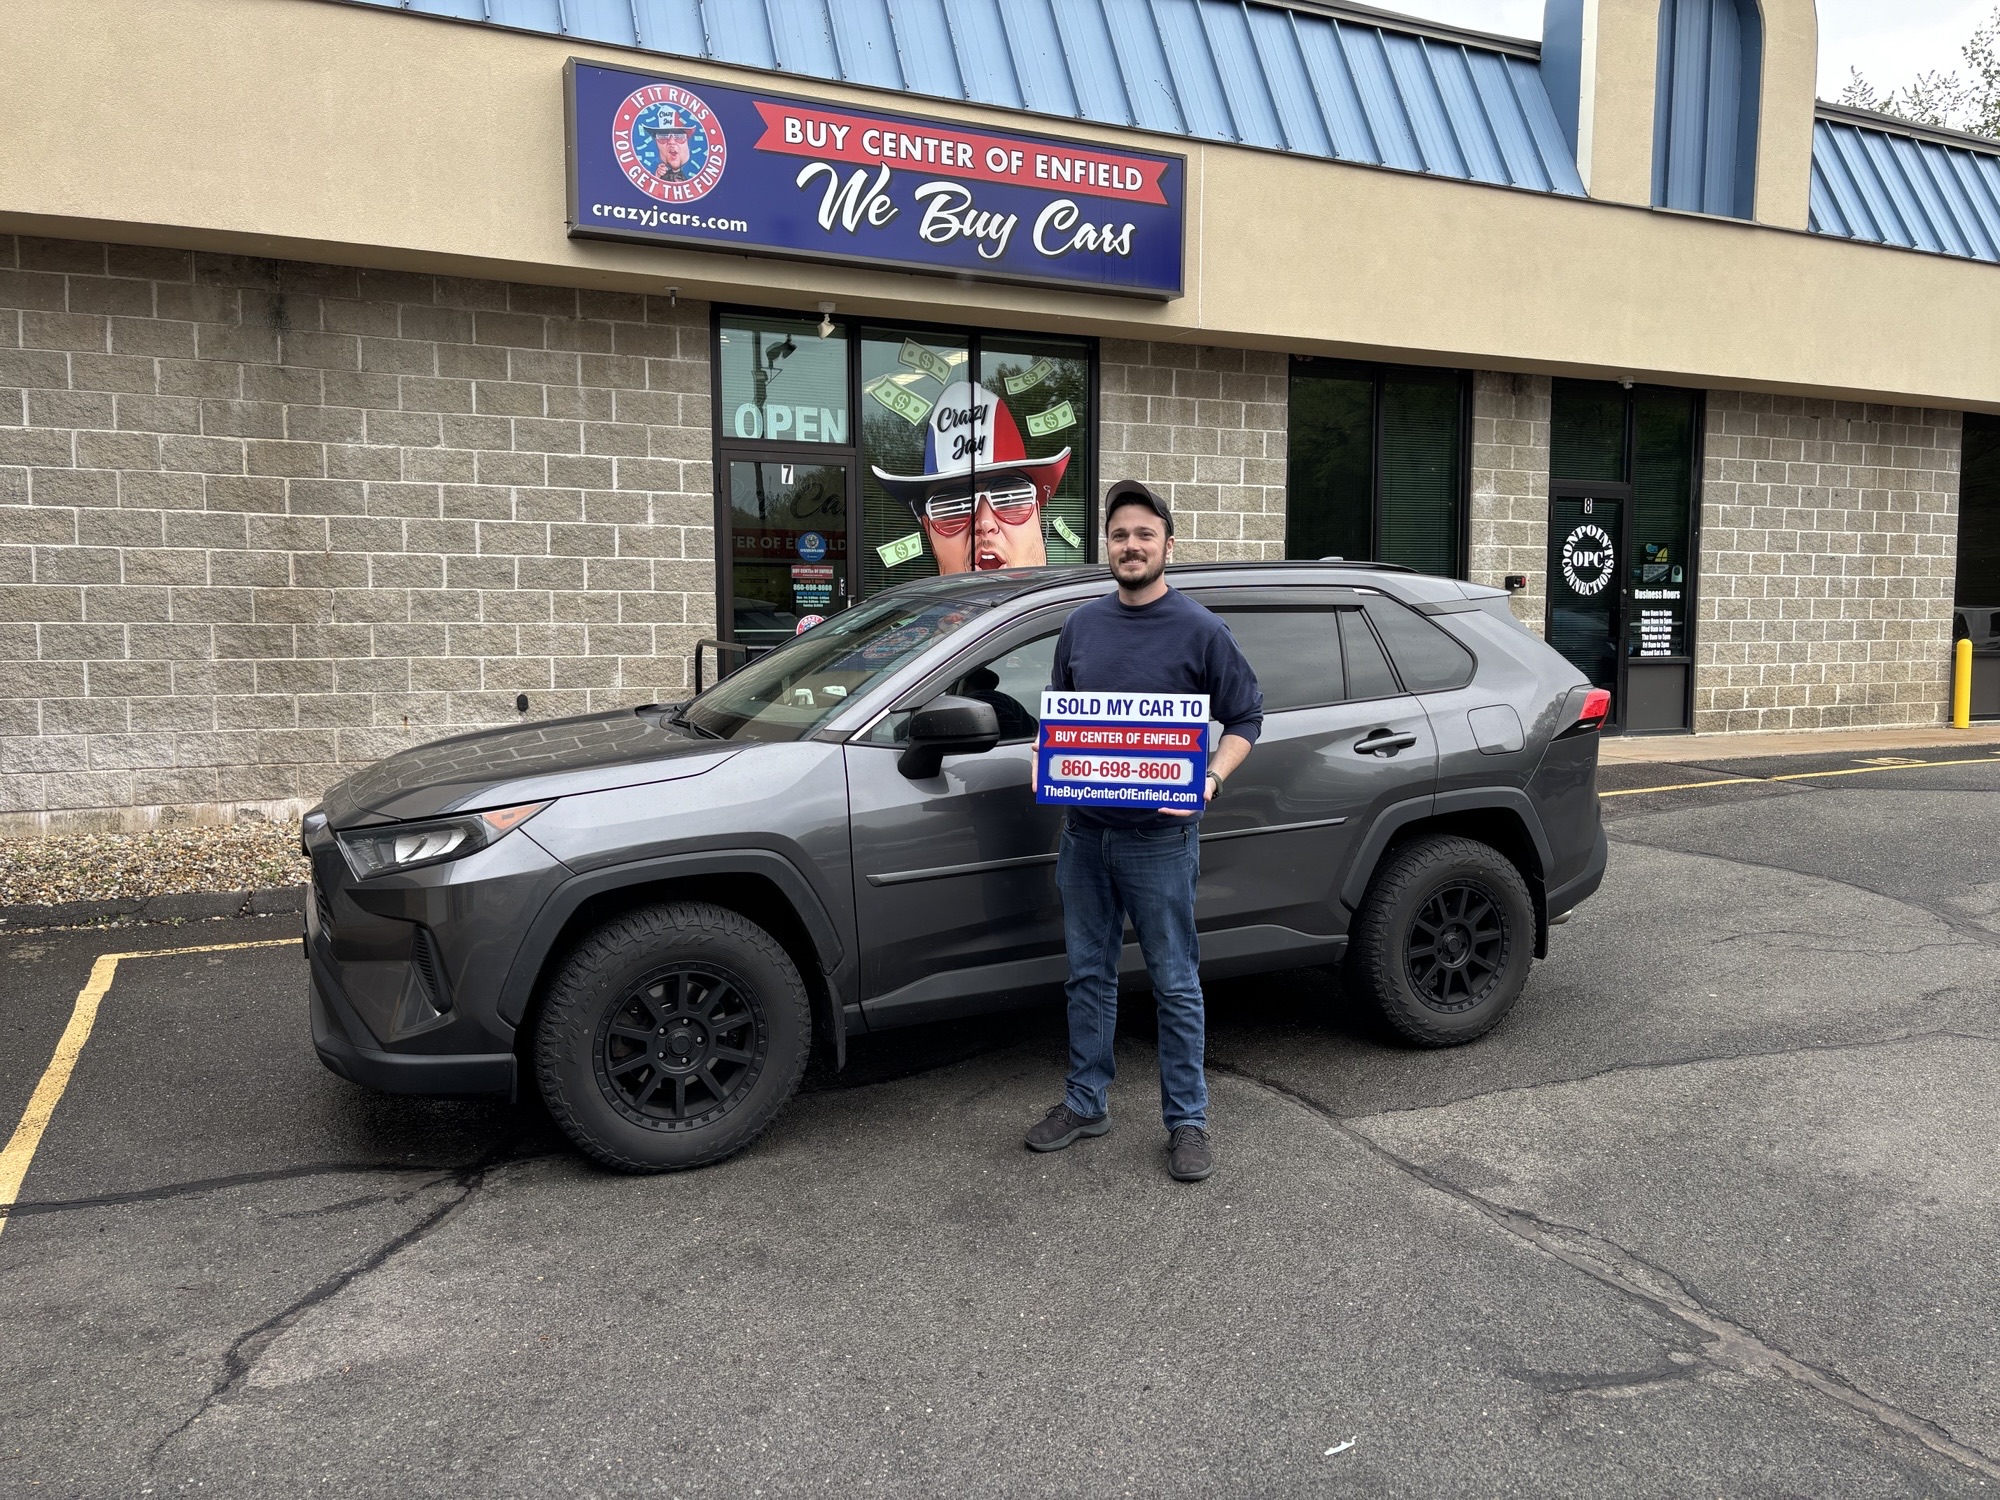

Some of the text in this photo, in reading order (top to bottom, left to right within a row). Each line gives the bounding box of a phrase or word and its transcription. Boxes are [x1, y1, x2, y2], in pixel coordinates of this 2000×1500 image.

[631, 87, 710, 120] IF IT RUNS
[615, 130, 723, 200] YOU GET THE FUNDS
[784, 116, 1143, 191] BUY CENTER OF ENFIELD
[592, 204, 748, 232] crazyjcars.com
[796, 161, 1136, 259] We Buy Cars
[735, 402, 847, 444] OPEN
[937, 404, 988, 433] Crazy
[952, 434, 986, 460] Jay
[783, 465, 791, 483] 7
[1585, 499, 1592, 513] 8
[760, 536, 781, 549] OF
[1563, 524, 1614, 558] ONPOINT
[1573, 551, 1604, 567] OPC
[1562, 558, 1614, 595] CONNECTIONS
[1635, 589, 1680, 599] Business Hours
[1047, 697, 1203, 718] I SOLD MY CAR TO
[1055, 731, 1191, 746] BUY CENTER OF ENFIELD
[1061, 759, 1181, 780] 860-698-8600
[1044, 785, 1198, 803] TheBuyCenterOfEnfield.com
